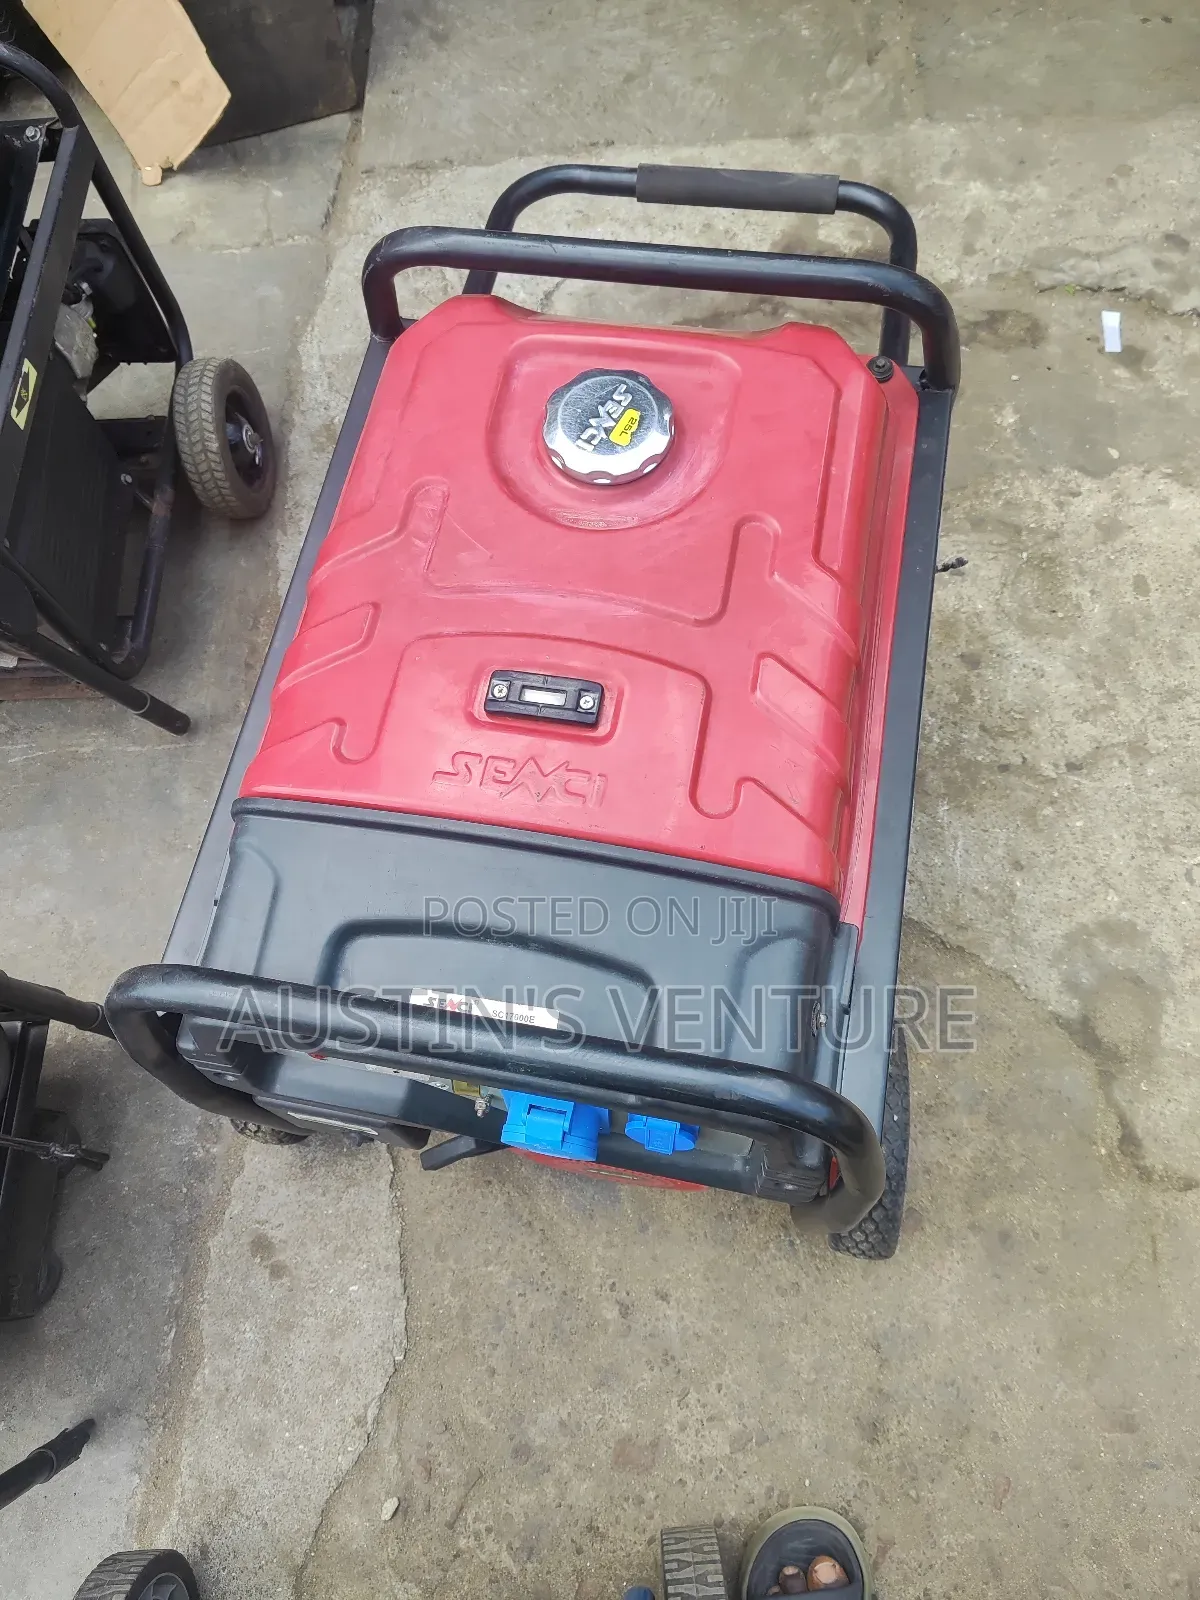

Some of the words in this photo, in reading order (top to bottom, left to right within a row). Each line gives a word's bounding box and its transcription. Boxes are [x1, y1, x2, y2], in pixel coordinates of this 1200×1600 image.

[576, 383, 633, 451] SENCI
[619, 416, 638, 437] 25L
[430, 750, 607, 808] SENCI
[423, 996, 474, 1014] SENCI
